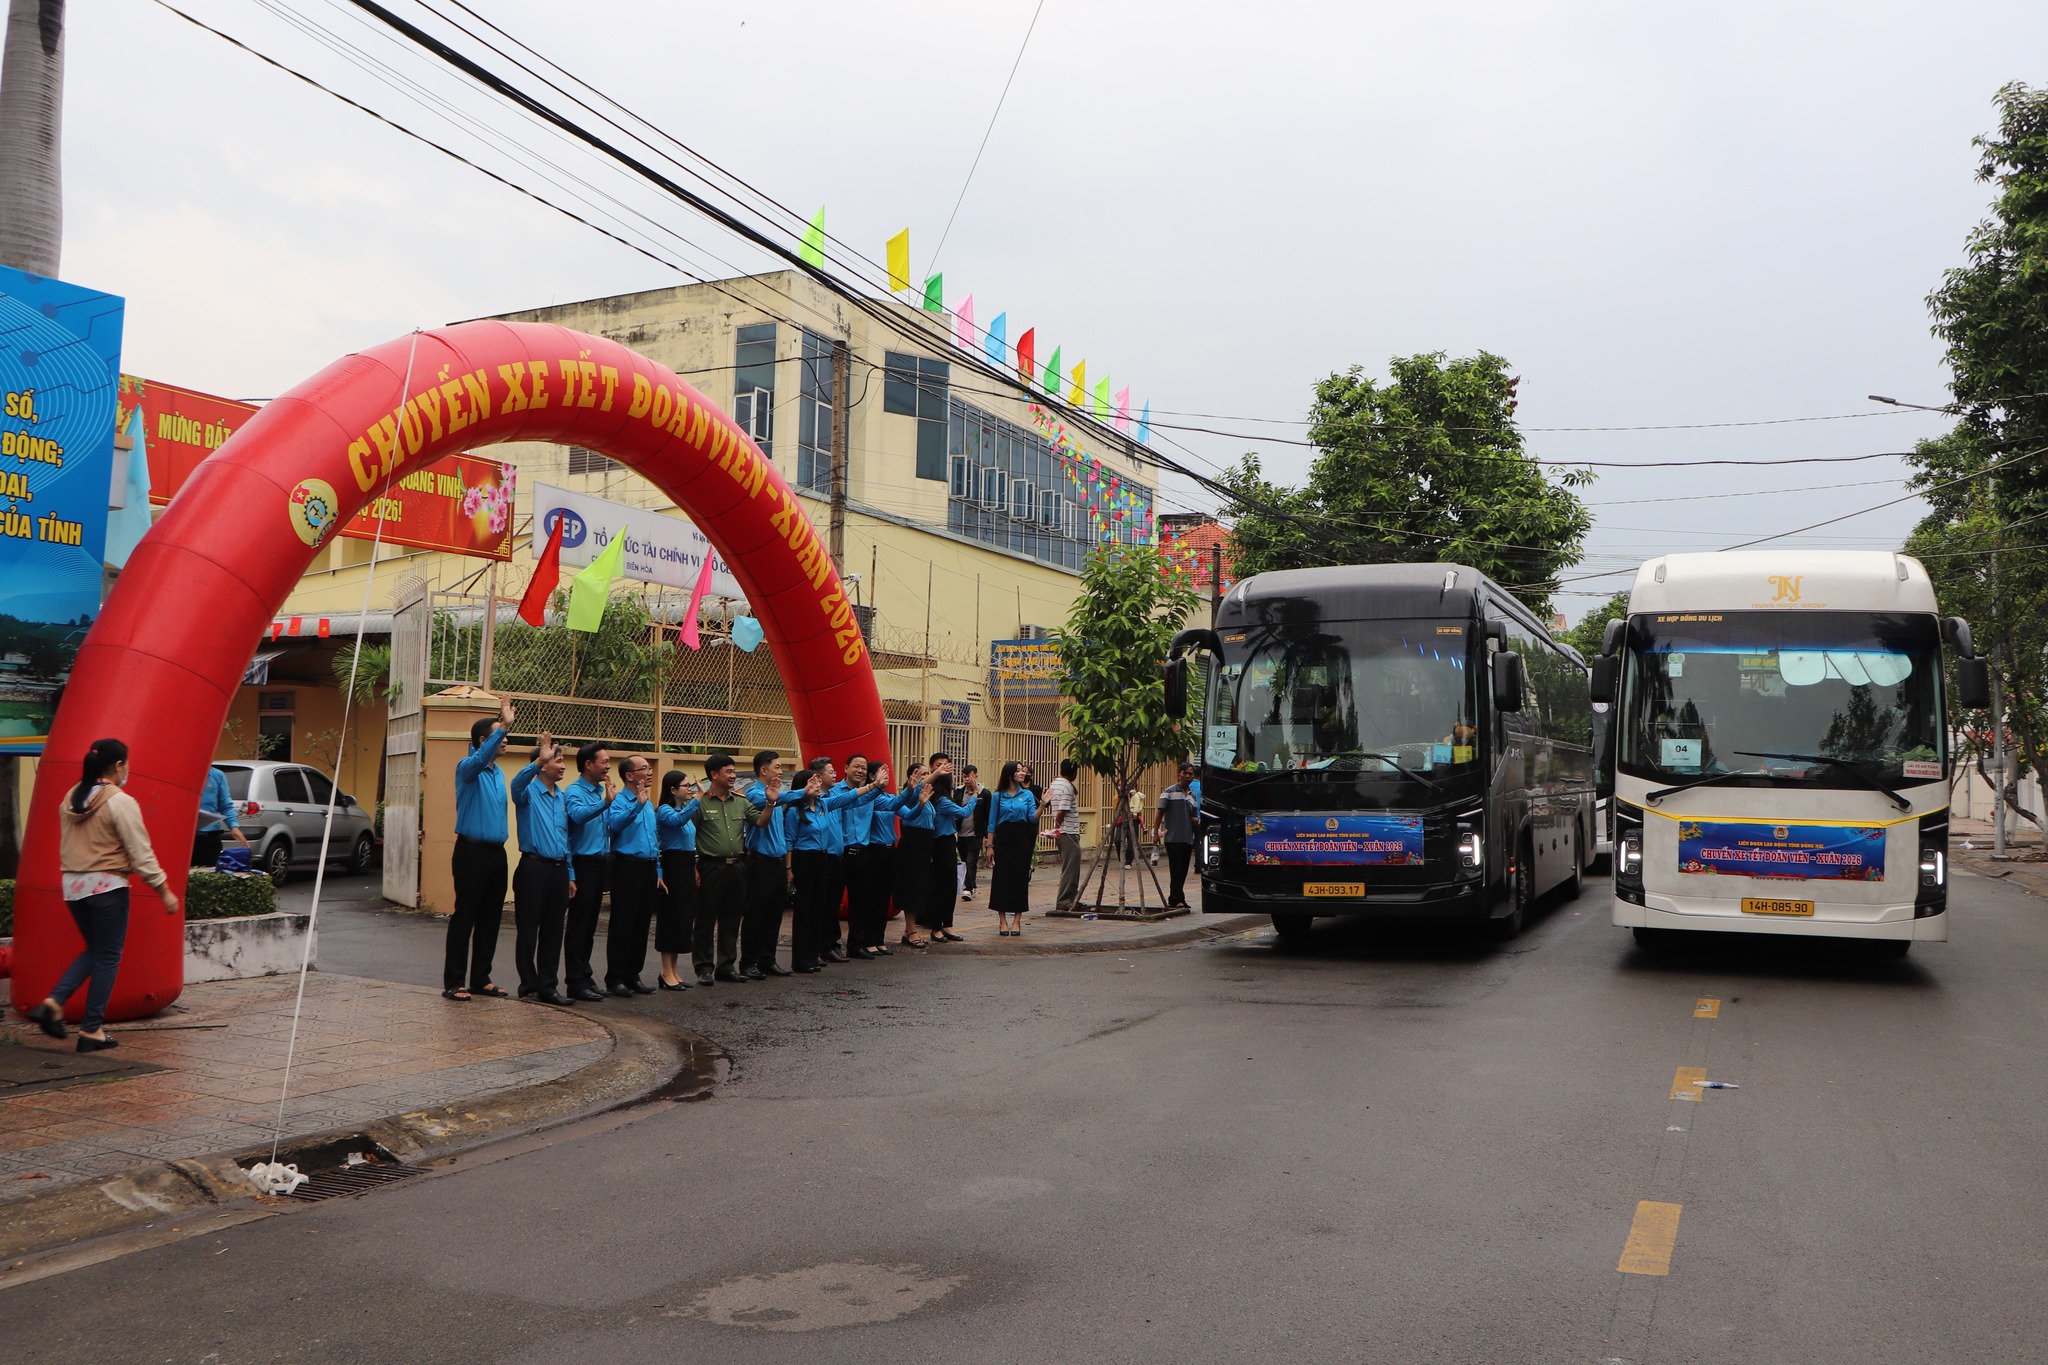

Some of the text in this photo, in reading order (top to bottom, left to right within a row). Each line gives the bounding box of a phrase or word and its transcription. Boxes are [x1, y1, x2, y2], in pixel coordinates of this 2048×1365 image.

[5, 388, 39, 424] SỐ,
[158, 410, 202, 446] MỪNG
[2, 429, 64, 468] ĐỘNG;
[348, 364, 491, 492] CHUYẾN
[497, 360, 549, 415] XE
[559, 349, 619, 412] TẾT
[628, 372, 710, 451] ĐOÀN
[708, 417, 768, 500] VIÊN
[769, 489, 832, 591] XUÂN
[820, 581, 864, 666] 2026
[371, 497, 403, 523] 2026!
[37, 511, 82, 546] TỈNH
[593, 526, 608, 547] TỔ
[641, 541, 657, 558] TÀI
[659, 547, 688, 565] CHÍNH
[691, 555, 700, 567] VI
[1265, 839, 1292, 852] CHUYẾN
[1293, 841, 1304, 852] XE
[1304, 839, 1318, 852] TẾT
[1319, 839, 1340, 852] ĐOÀN
[1340, 839, 1357, 852] VIÊN
[1363, 839, 1385, 852] XUÂN
[1385, 841, 1403, 852] 2026
[1701, 845, 1733, 860] CHUYẾN
[1733, 850, 1747, 861] XE
[1748, 847, 1764, 861] TẾT
[1765, 849, 1789, 863] ĐOÀN
[1789, 850, 1809, 864] VIÊN
[1816, 851, 1841, 864] XUÂN
[1841, 853, 1862, 865] 2026
[1308, 885, 1360, 895] 43H-093.17
[1749, 901, 1808, 913] 14H-085.90
